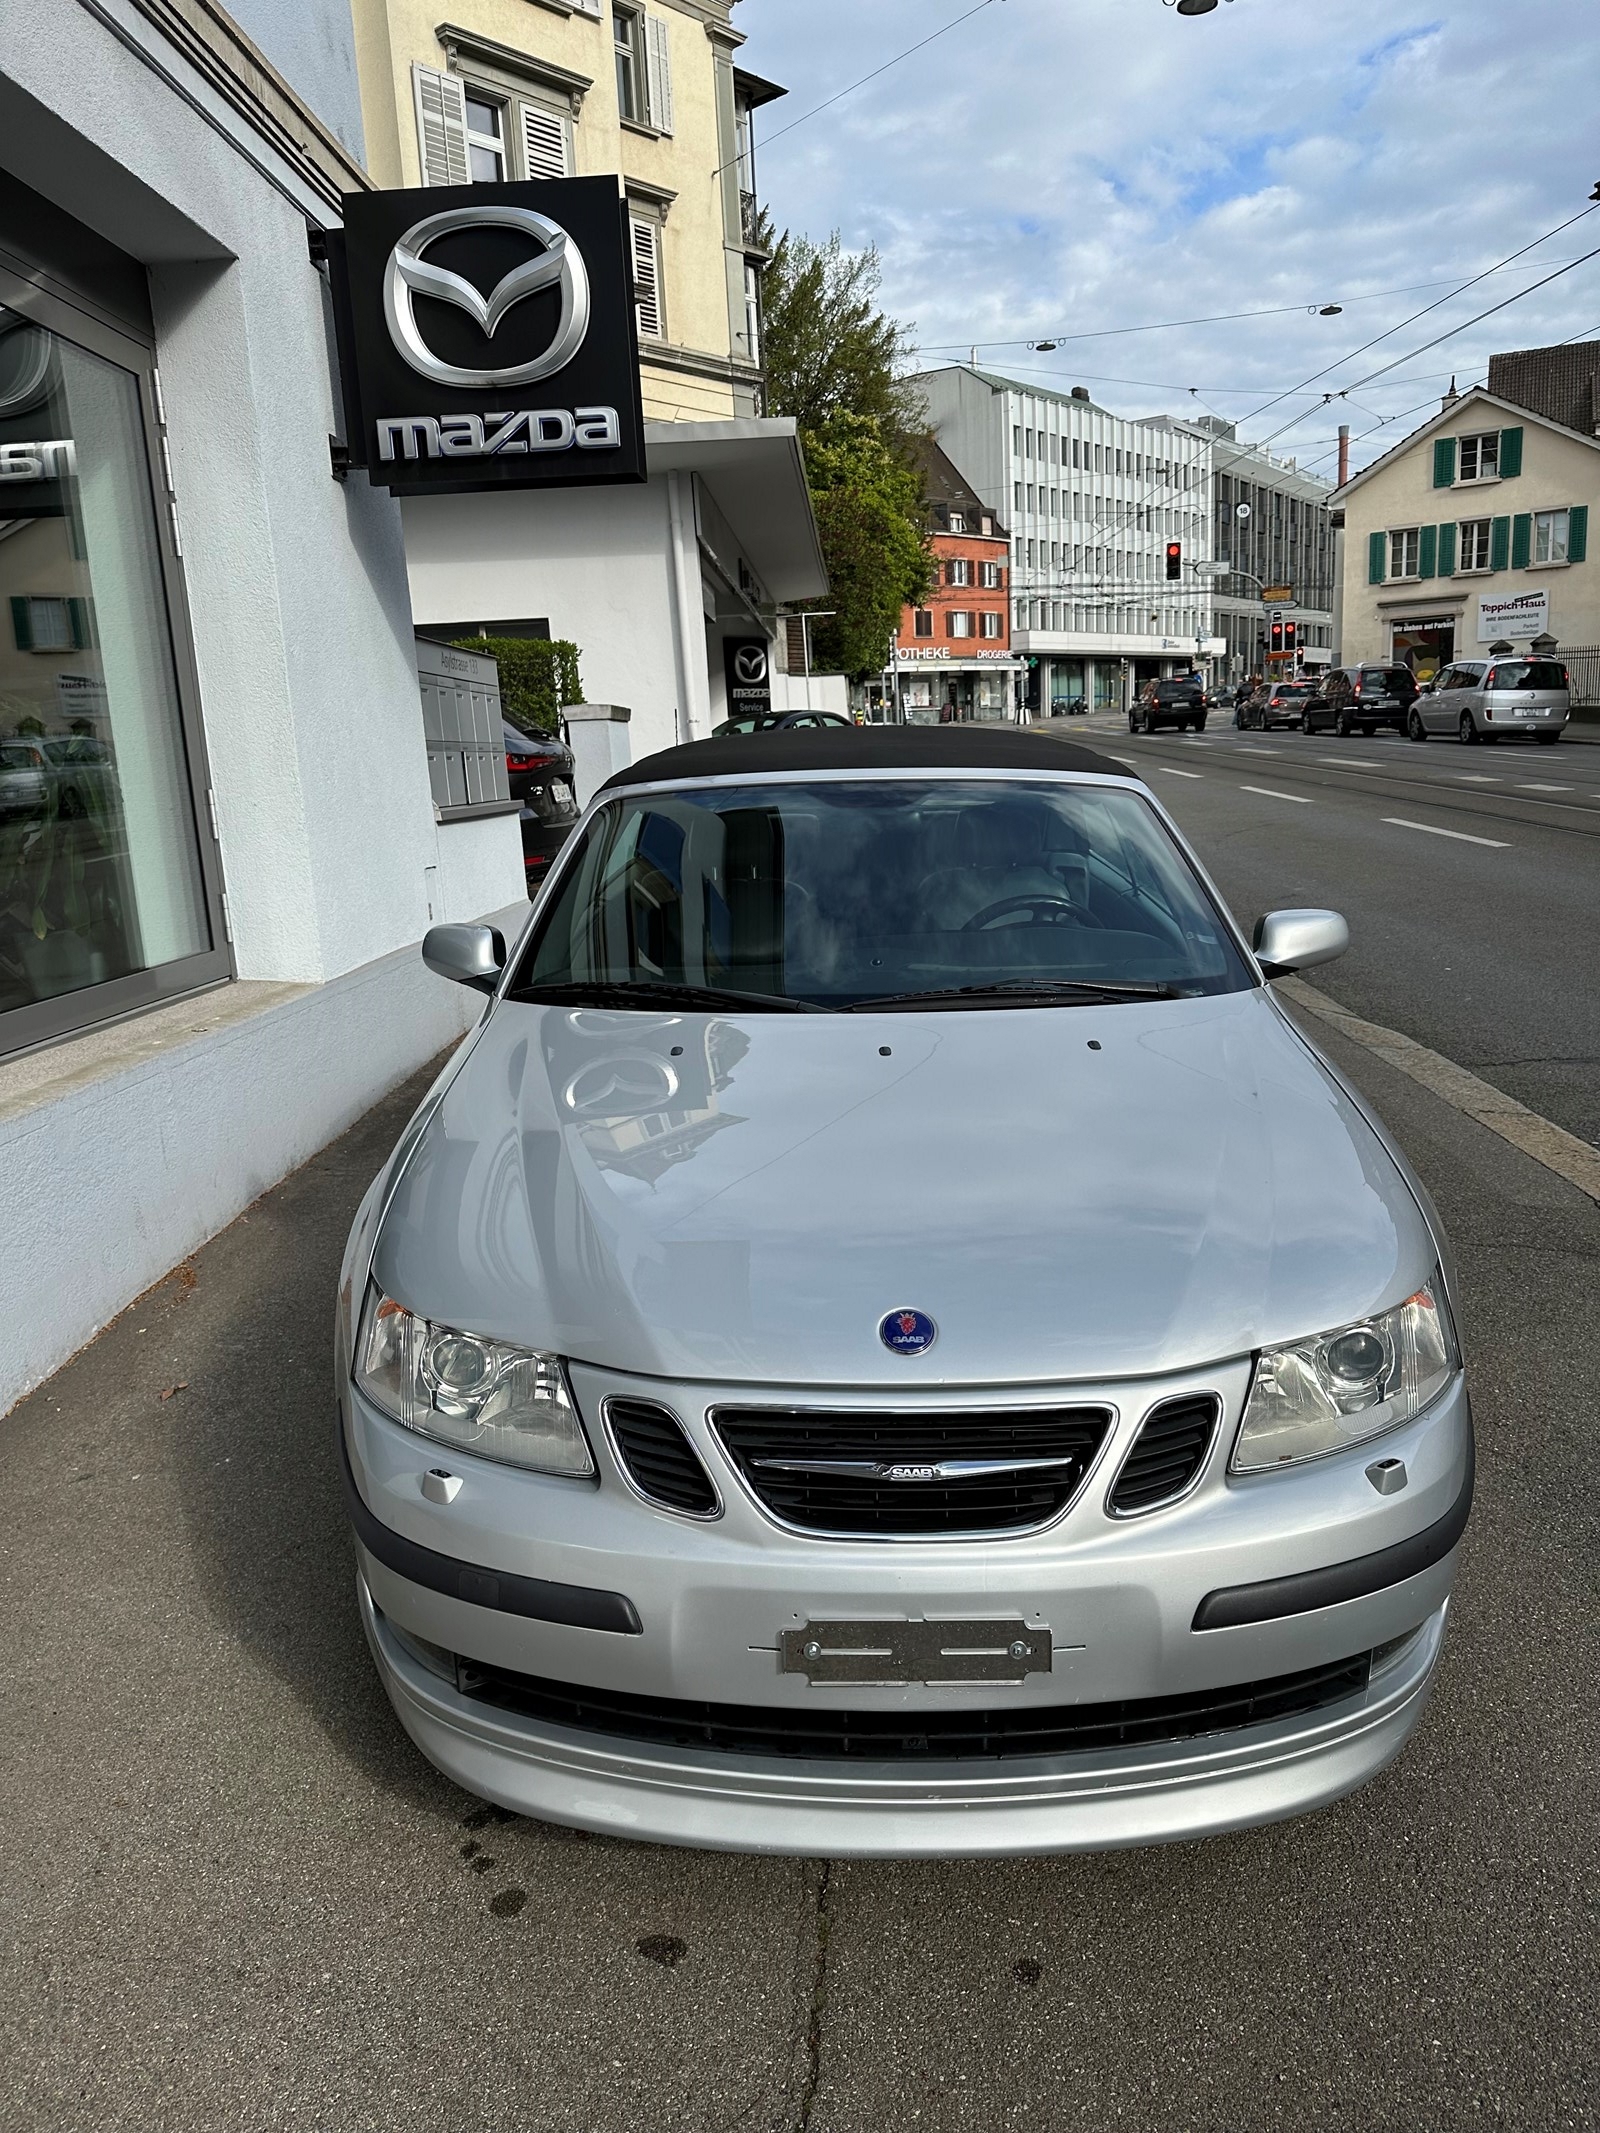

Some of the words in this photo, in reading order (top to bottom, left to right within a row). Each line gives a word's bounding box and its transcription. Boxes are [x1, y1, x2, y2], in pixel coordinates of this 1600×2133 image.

[1239, 507, 1248, 515] 18
[1481, 599, 1546, 613] Teppich-Haus
[976, 649, 1014, 659] DROGERIE
[441, 651, 469, 673] Asylstrasse
[469, 657, 479, 675] 133
[739, 702, 764, 712] Service
[893, 1335, 925, 1343] SAAB
[891, 1468, 933, 1478] SAAB
